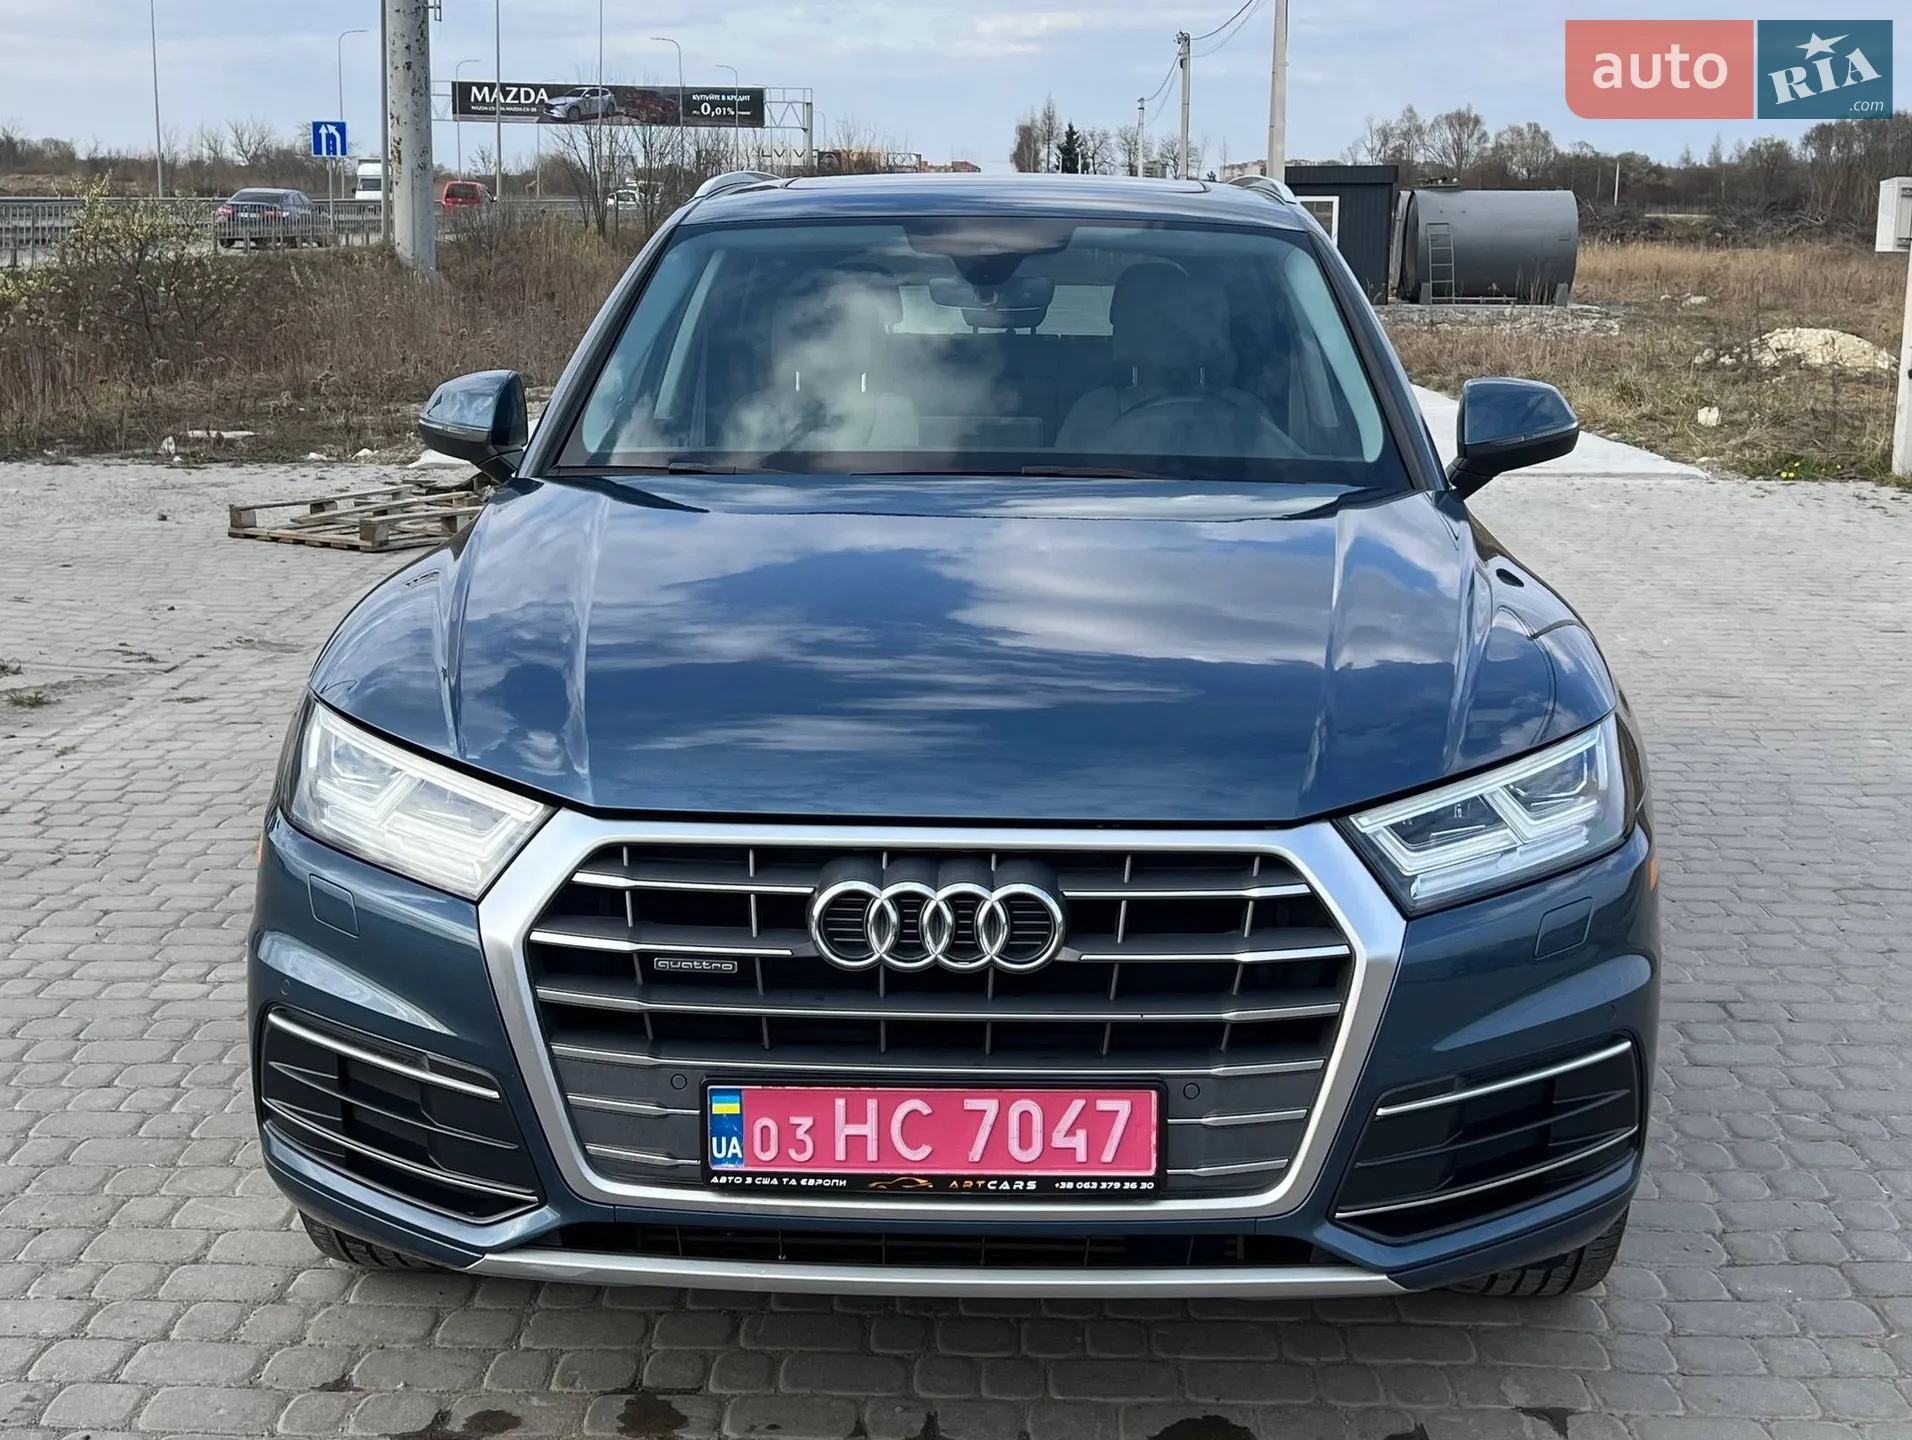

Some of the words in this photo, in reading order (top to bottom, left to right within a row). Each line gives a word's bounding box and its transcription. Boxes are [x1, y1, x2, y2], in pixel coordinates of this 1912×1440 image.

[471, 86, 549, 104] MAZDA
[657, 960, 733, 970] quattro
[753, 1115, 814, 1162] 03
[834, 1098, 933, 1162] HC
[963, 1099, 1132, 1163] 7047
[711, 1136, 743, 1158] UA
